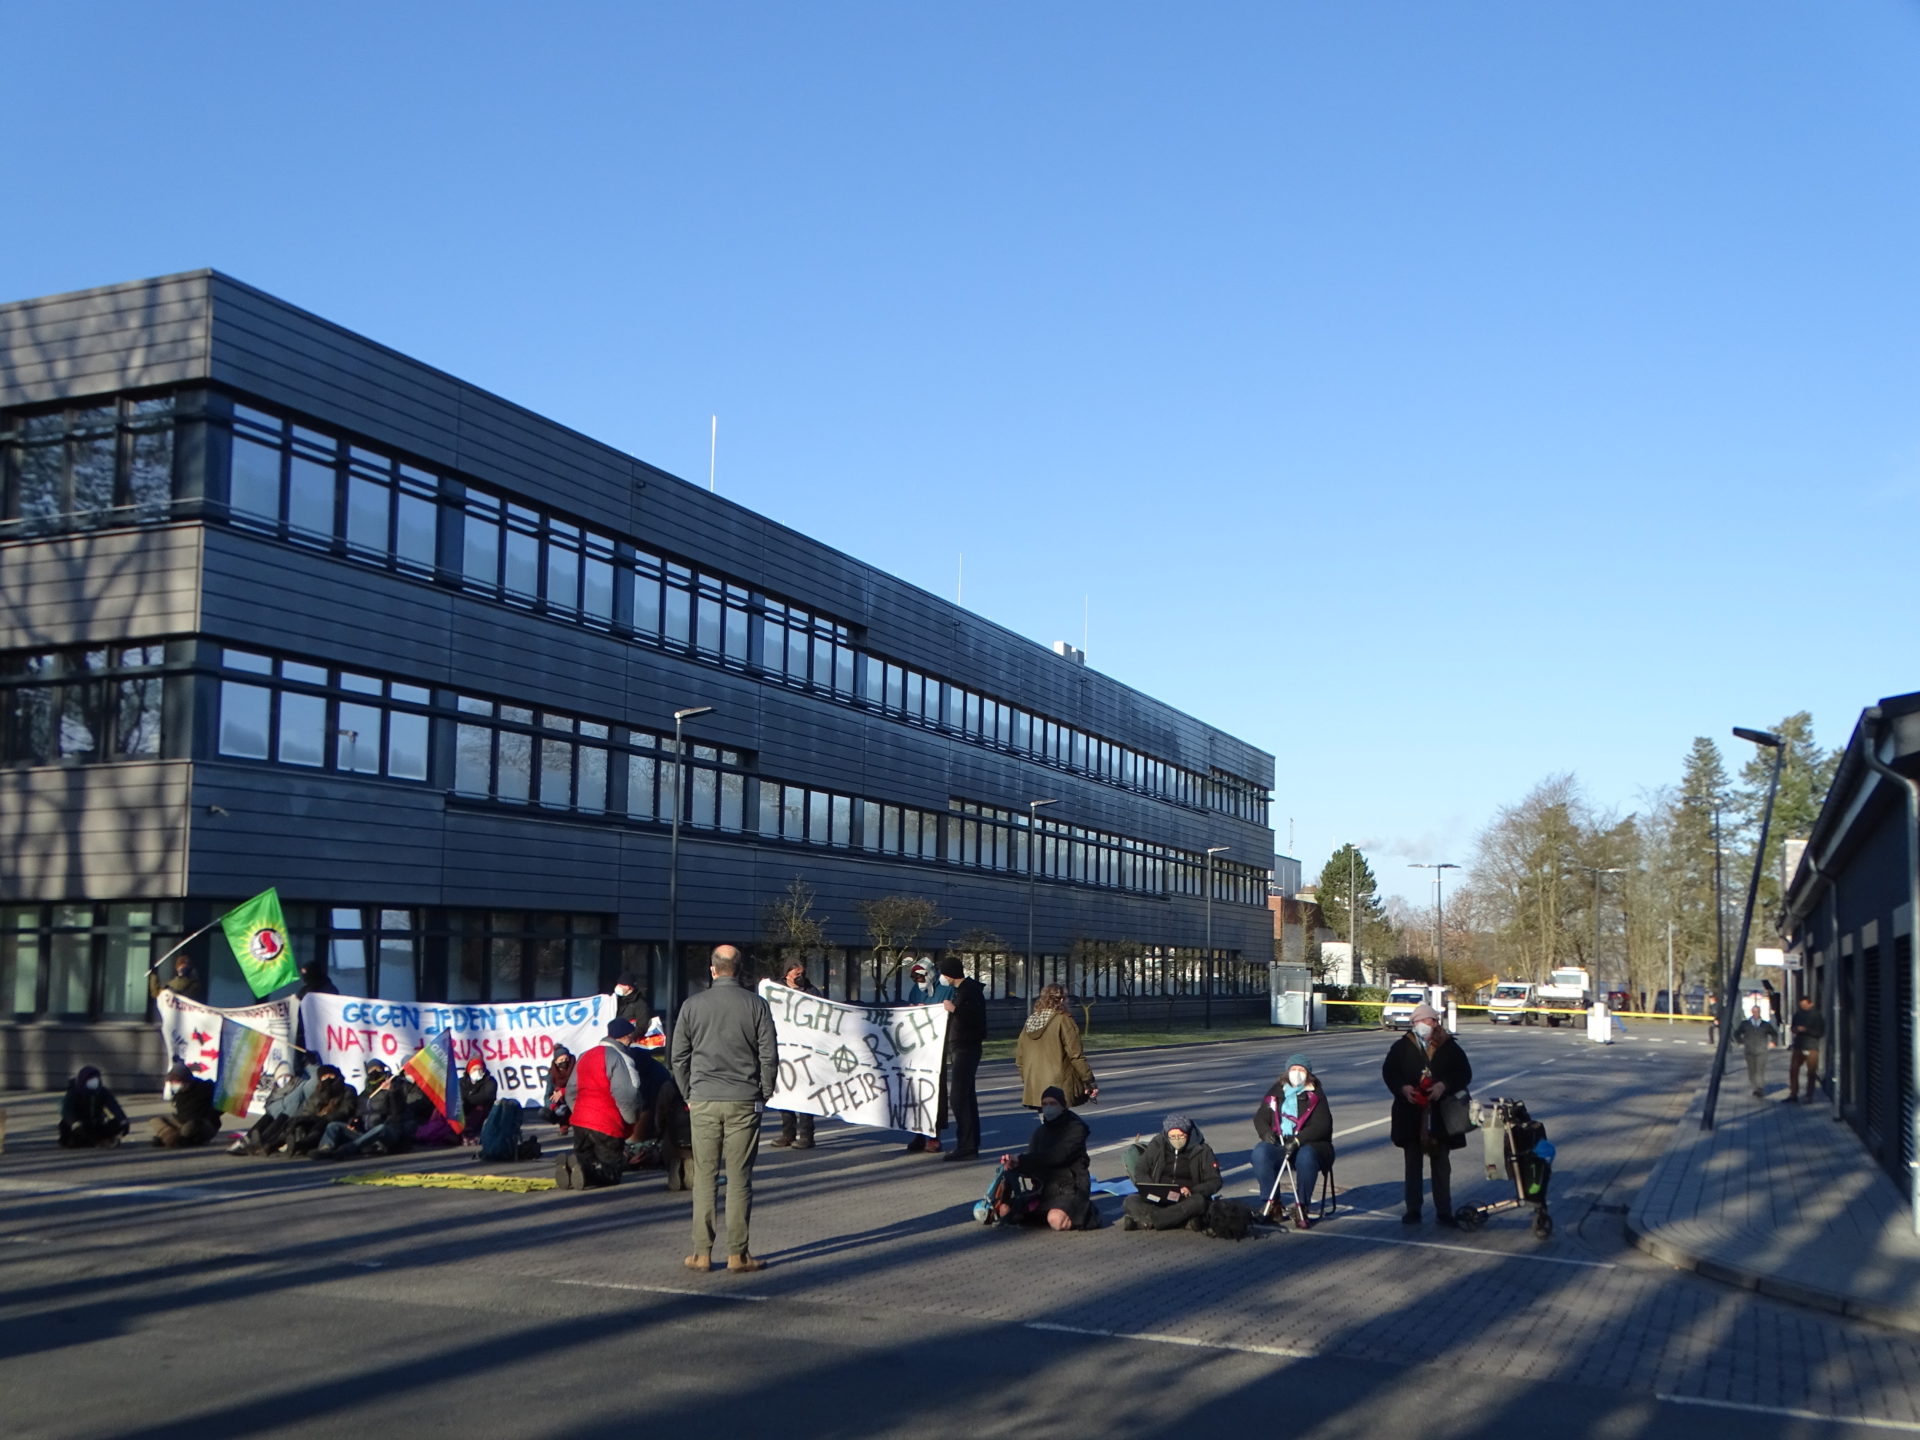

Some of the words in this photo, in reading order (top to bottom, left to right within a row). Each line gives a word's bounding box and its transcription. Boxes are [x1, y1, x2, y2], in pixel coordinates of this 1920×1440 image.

[343, 1003, 419, 1030] GEGEN
[424, 1006, 497, 1035] JEDEN
[765, 985, 853, 1036] FIGHT
[862, 1008, 895, 1026] THE
[326, 1024, 398, 1056] NATO
[452, 1035, 555, 1062] RUSSLAND
[863, 1008, 938, 1067] RICH
[775, 1054, 815, 1094] OT
[807, 1072, 890, 1117] THEIR
[880, 1071, 936, 1133] WAR
